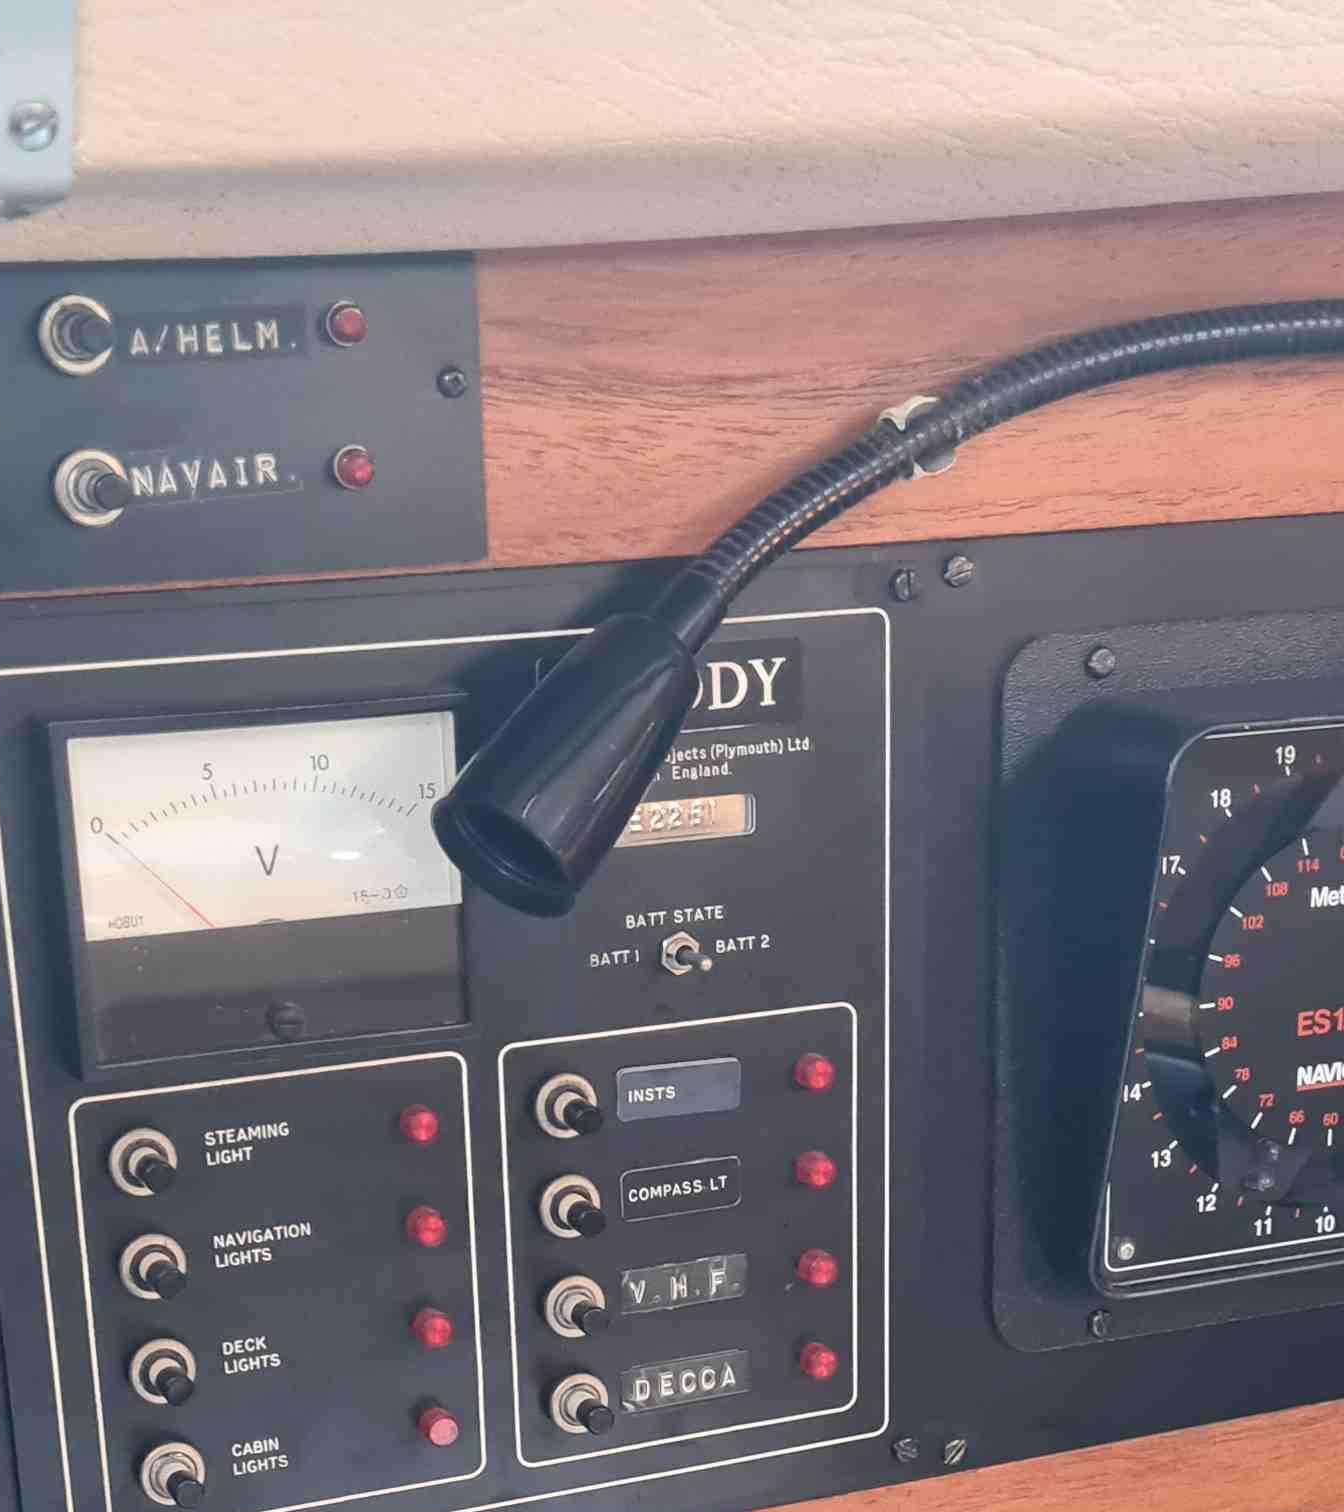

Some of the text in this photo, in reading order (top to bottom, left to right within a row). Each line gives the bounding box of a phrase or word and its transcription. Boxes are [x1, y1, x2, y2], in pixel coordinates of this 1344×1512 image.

[693, 657, 787, 710] DY
[710, 737, 809, 761] (Plymouth) Ltd
[1275, 745, 1295, 764] 19
[202, 763, 213, 780] 5
[310, 754, 330, 772] 10
[418, 783, 437, 800] 15
[1210, 788, 1231, 807] 18
[90, 817, 103, 834] 0
[255, 845, 279, 876] V
[1162, 856, 1179, 874] 17
[1297, 859, 1320, 873] 114
[626, 905, 724, 930] BATT STATE
[1242, 916, 1264, 930] 102
[716, 934, 771, 953] BATT 2
[590, 951, 633, 967] BATT
[628, 1085, 676, 1103] INSTS
[1123, 1084, 1142, 1101] 14
[1258, 1094, 1274, 1107] 72
[204, 1122, 290, 1146] STEAMING
[206, 1147, 254, 1166] LIGHT
[1151, 1150, 1171, 1168] 13
[628, 1174, 729, 1203] COMPASS LT
[1196, 1195, 1217, 1212] 12
[1254, 1219, 1271, 1235] 11
[1315, 1215, 1335, 1233] 10
[213, 1222, 311, 1248] NAVIGATION
[215, 1248, 272, 1268] LIGHTS
[222, 1336, 266, 1356] DECK
[224, 1353, 281, 1374] LIGHTS
[635, 1362, 736, 1401] DECCA
[231, 1436, 280, 1457] CABIN
[233, 1454, 289, 1476] LIGHTS
